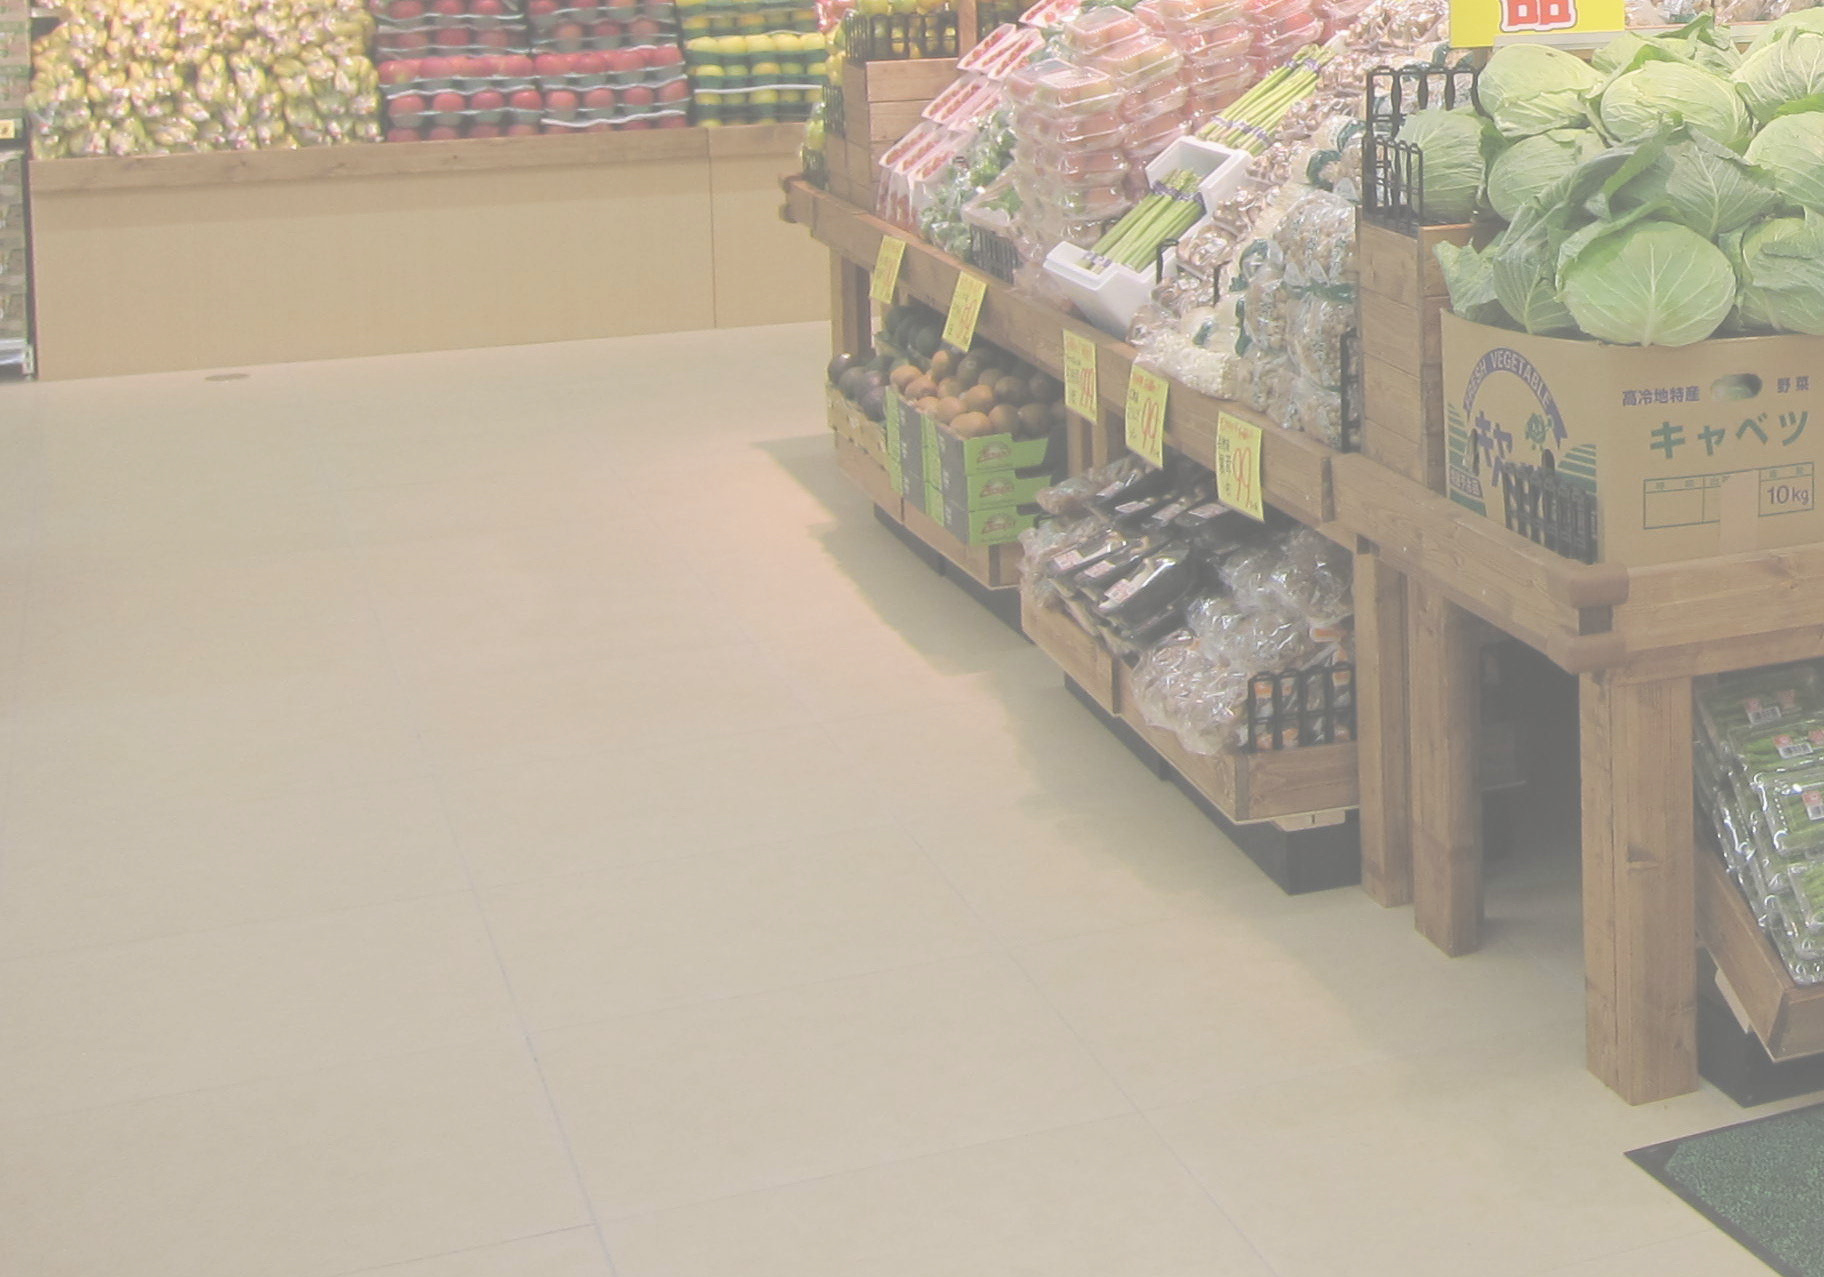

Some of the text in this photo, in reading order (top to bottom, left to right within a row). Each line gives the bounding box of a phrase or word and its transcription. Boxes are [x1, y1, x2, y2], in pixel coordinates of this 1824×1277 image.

[1489, 348, 1552, 404] VEGETABLE
[1622, 376, 1810, 407] 高冷地特産 野菜
[1650, 410, 1809, 459] キャベツ
[1766, 485, 1810, 506] 10kg
